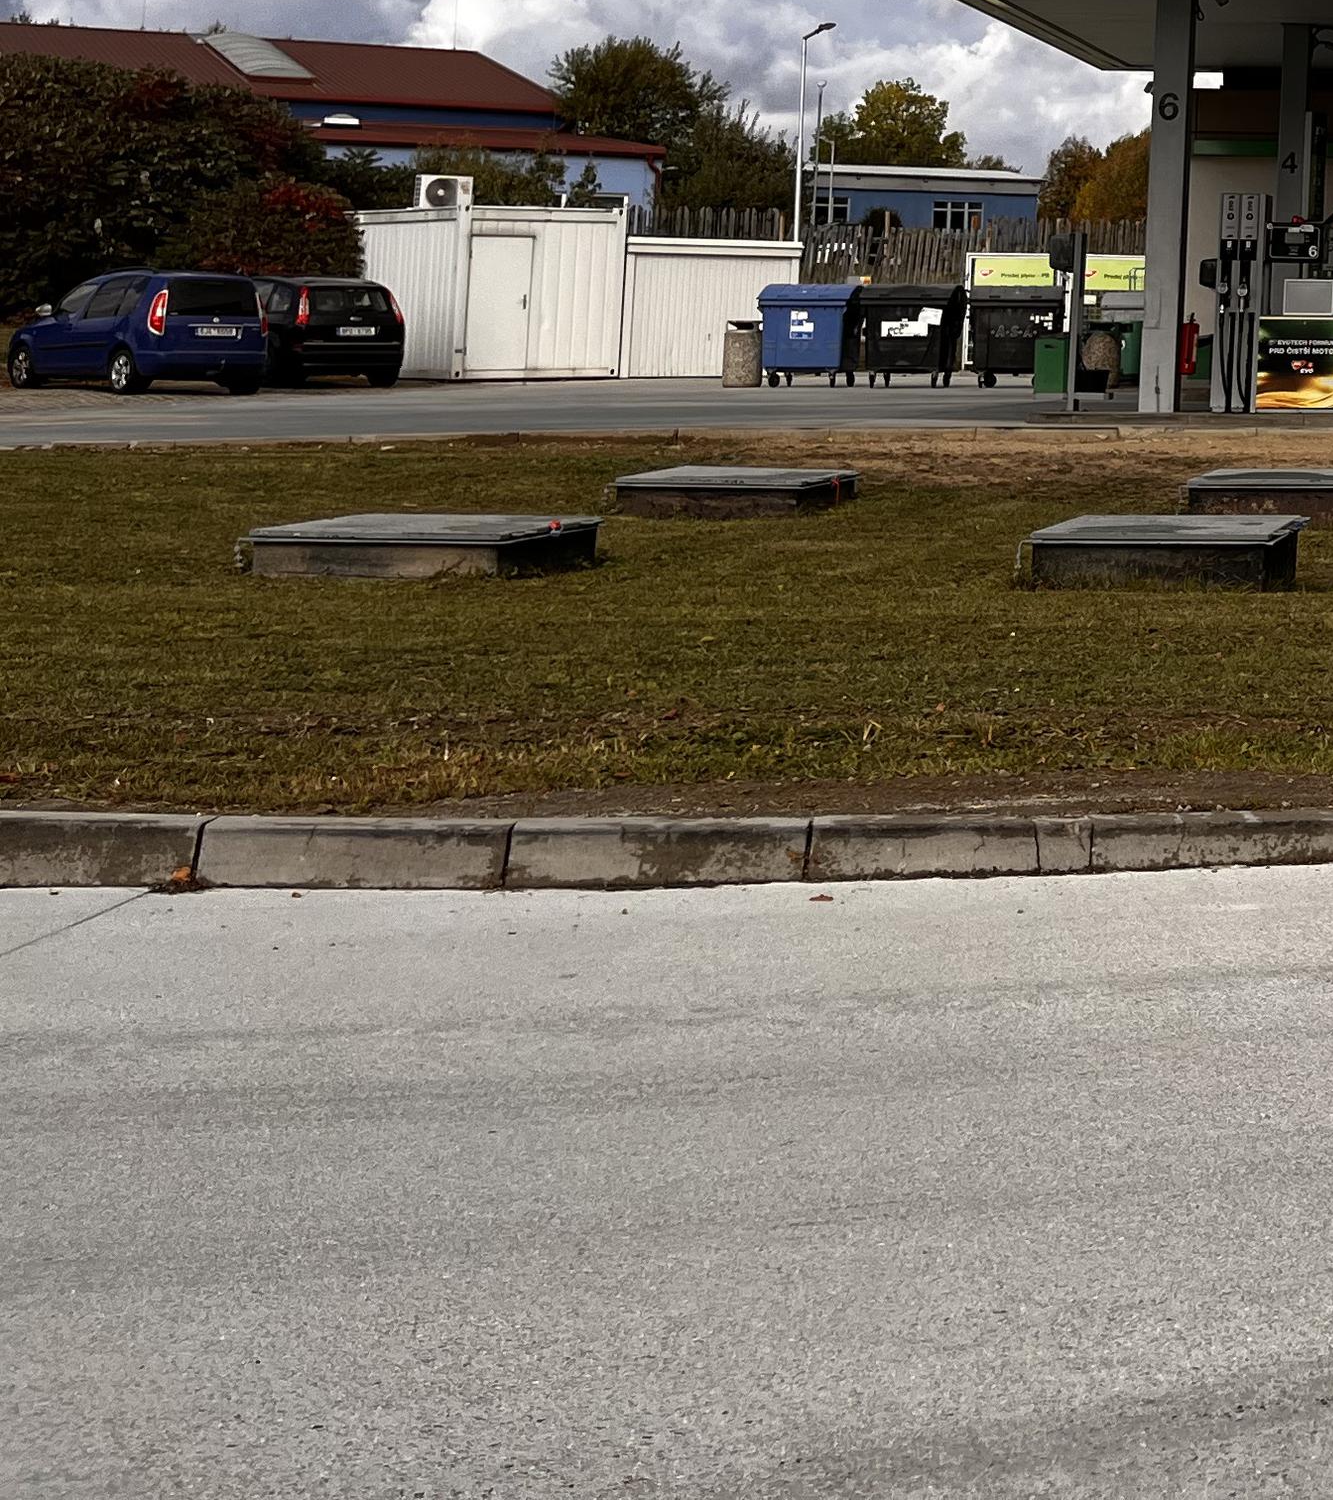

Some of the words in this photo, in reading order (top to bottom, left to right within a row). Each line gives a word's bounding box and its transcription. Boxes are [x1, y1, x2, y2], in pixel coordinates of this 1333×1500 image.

[1158, 92, 1179, 121] 6
[1281, 151, 1298, 174] 4
[1308, 245, 1319, 258] 6
[1268, 347, 1285, 355] PRO
